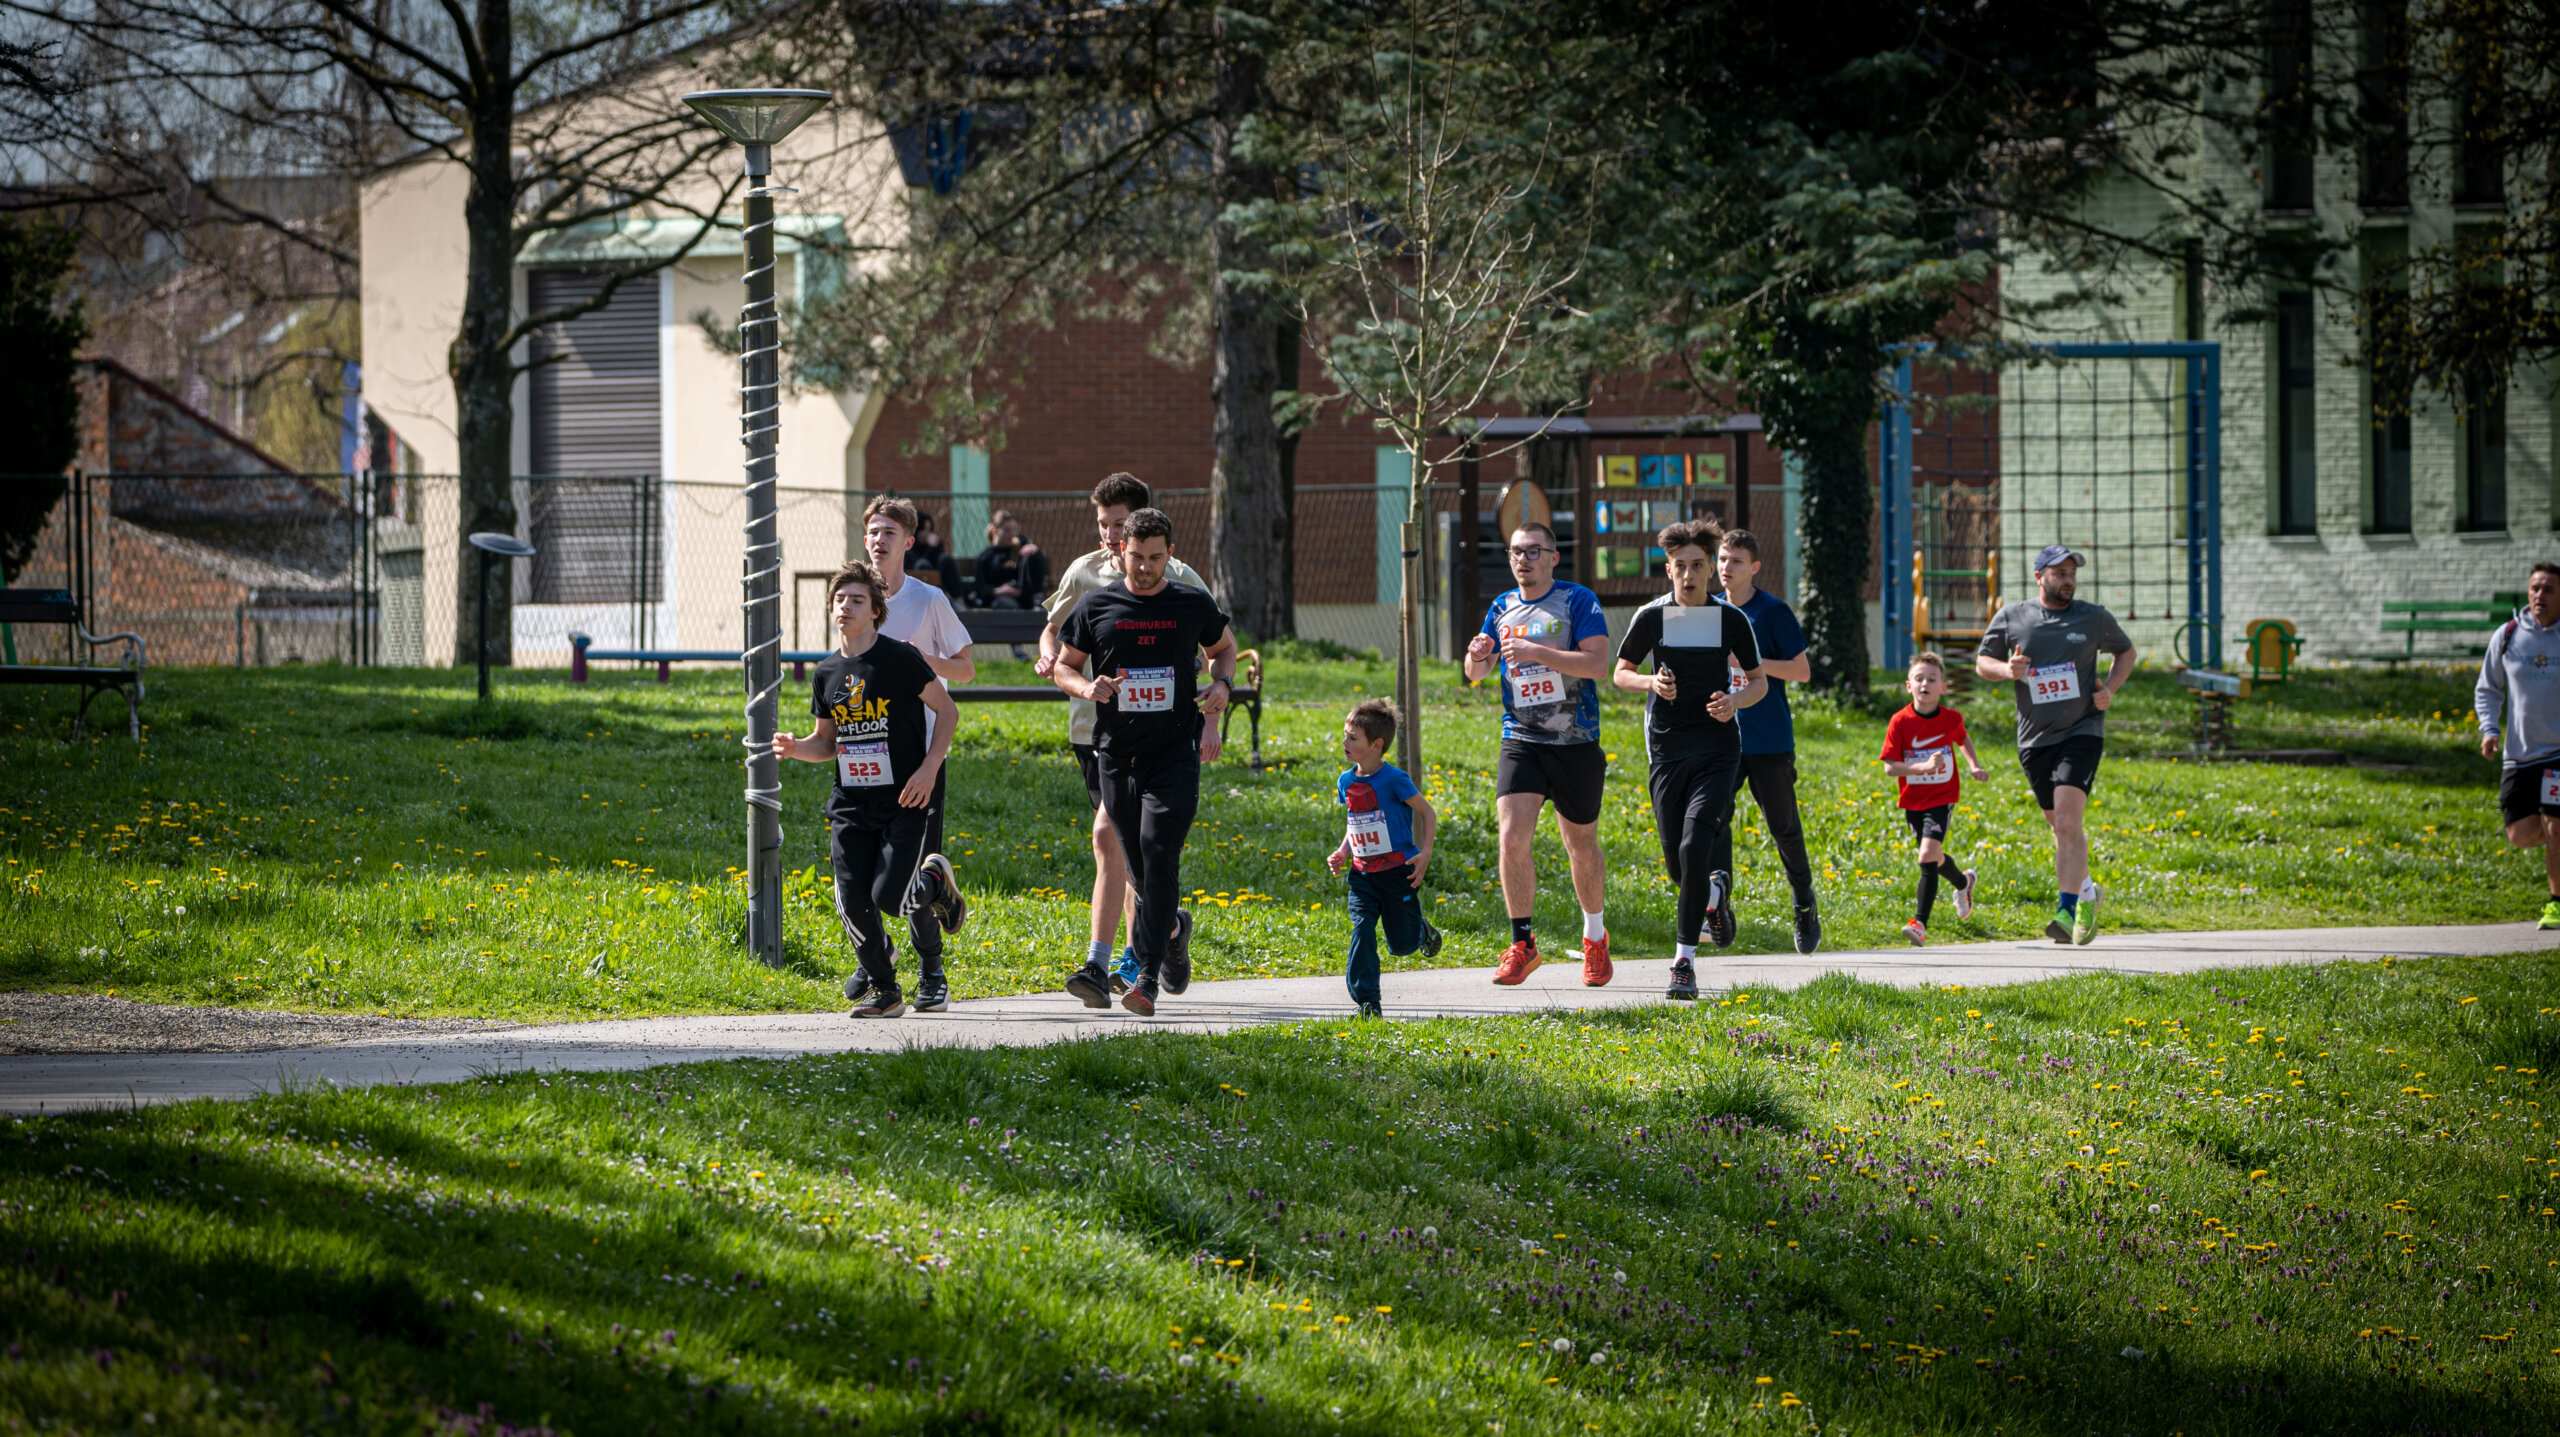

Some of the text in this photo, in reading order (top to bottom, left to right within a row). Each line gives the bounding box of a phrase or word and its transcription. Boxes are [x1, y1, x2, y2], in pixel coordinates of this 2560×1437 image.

[1137, 635, 1157, 645] ZET
[1128, 687, 1166, 702] 145
[1521, 680, 1555, 698] 278
[2037, 679, 2071, 695] 391
[847, 717, 889, 735] FLOOR
[848, 762, 881, 777] 523
[1350, 831, 1381, 847] 144
